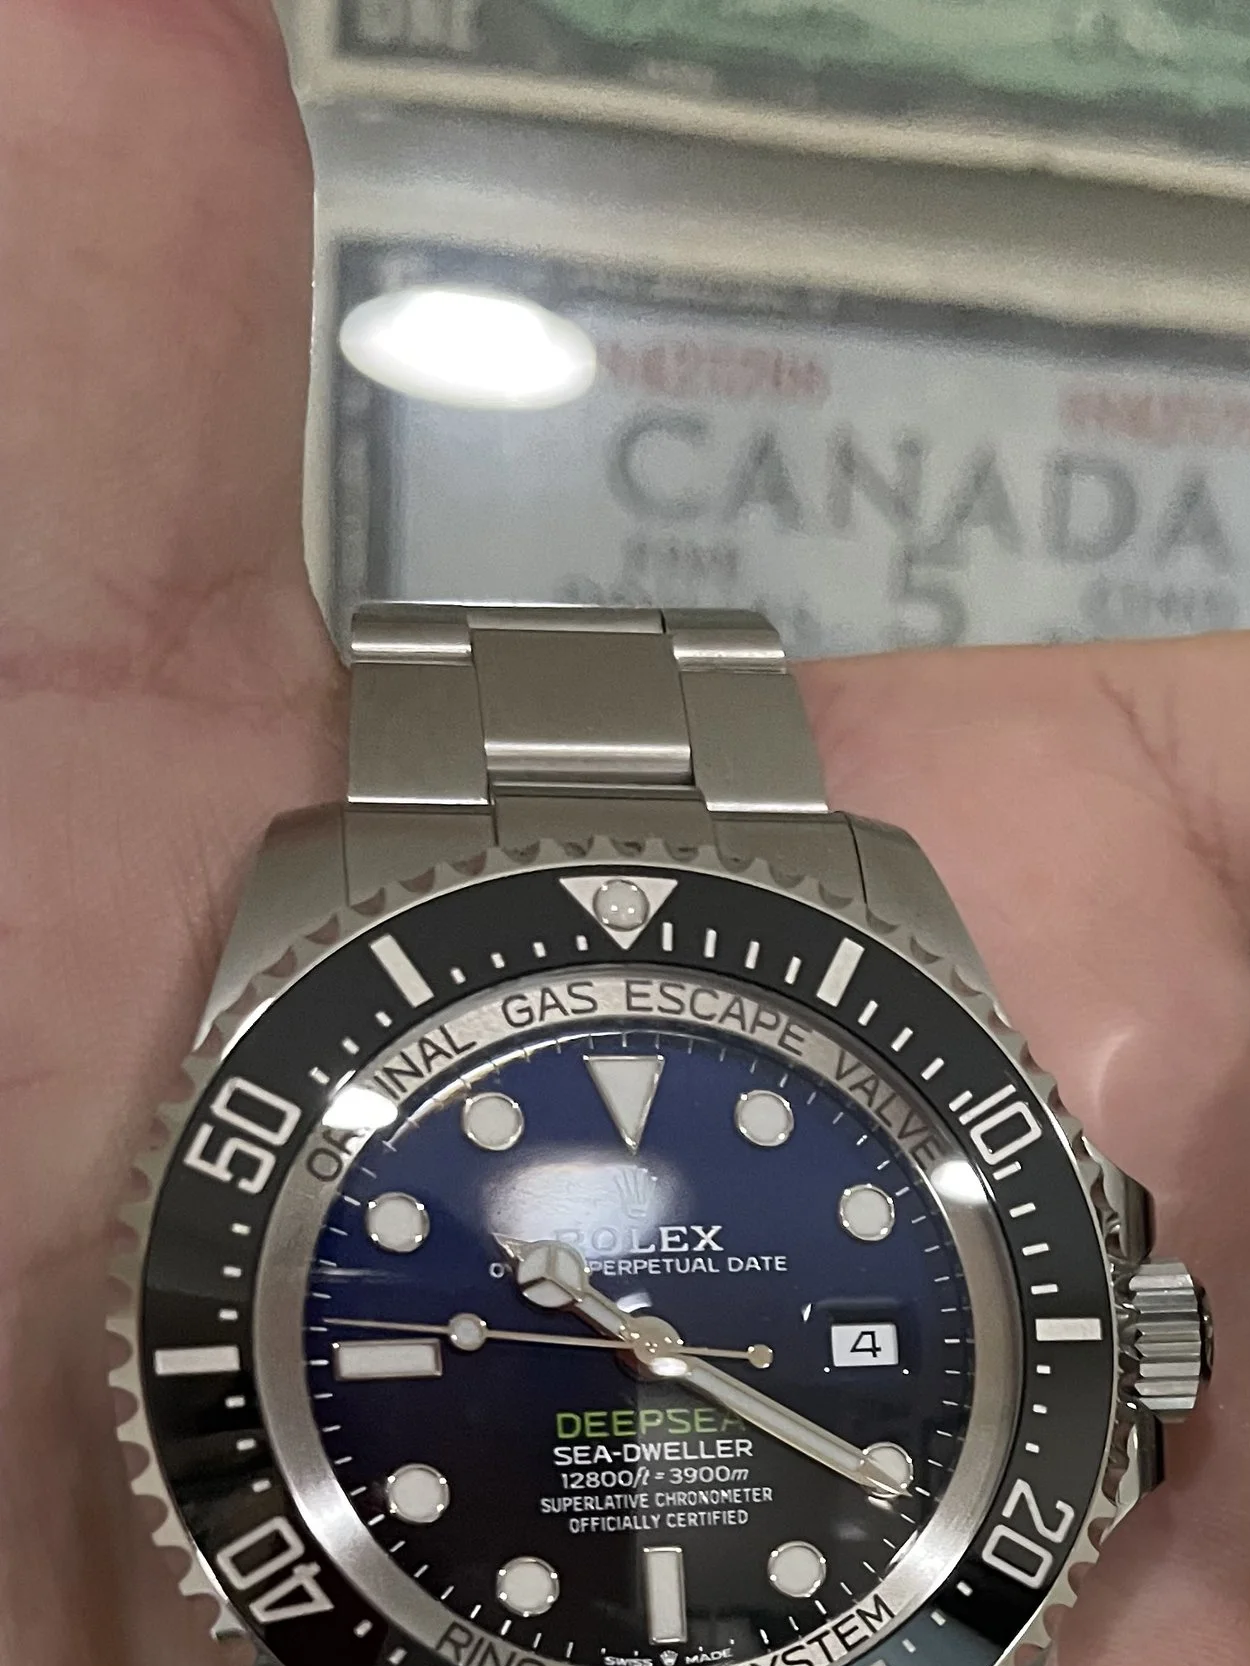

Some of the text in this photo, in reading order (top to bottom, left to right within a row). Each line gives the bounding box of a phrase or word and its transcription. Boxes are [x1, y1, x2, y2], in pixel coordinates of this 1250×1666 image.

[606, 408, 1238, 572] CANADA
[306, 978, 947, 1182] ORINAL GAS ESCAPE VALVE
[183, 1076, 301, 1194] 50
[958, 1083, 1043, 1166] 10
[554, 1225, 724, 1255] ROLEX
[589, 1255, 788, 1277] PERPETUAL DATE
[849, 1330, 882, 1358] 4
[556, 1408, 747, 1439] DEEPSEA
[553, 1439, 754, 1467] SEA-DWELLER
[541, 1487, 773, 1514] SUPERLATIVE CHRONOMETER
[569, 1510, 749, 1534] OFFICIALLY CERTIFIED
[982, 1477, 1076, 1590] 20
[216, 1515, 335, 1624] 40
[685, 1648, 735, 1665] MADE
